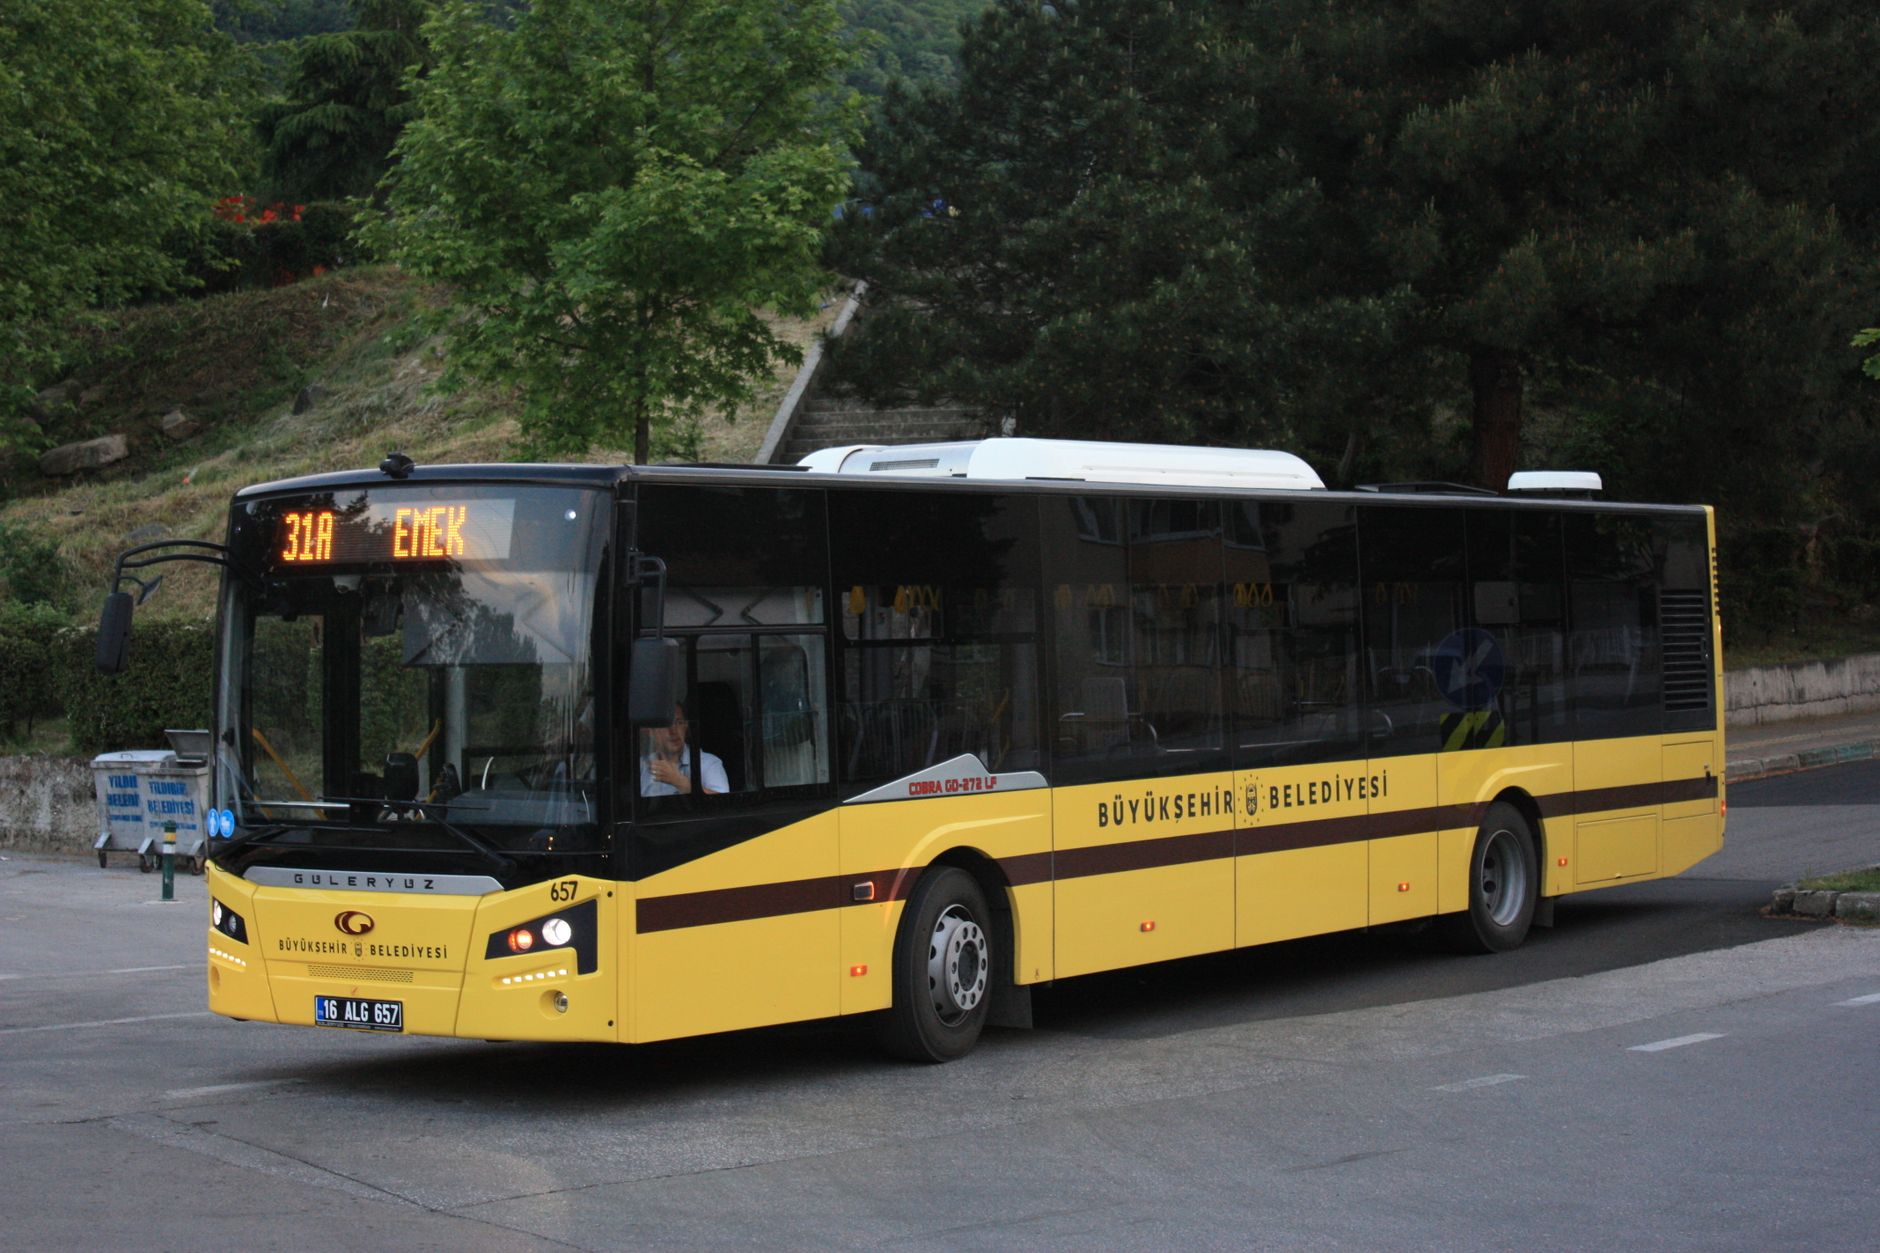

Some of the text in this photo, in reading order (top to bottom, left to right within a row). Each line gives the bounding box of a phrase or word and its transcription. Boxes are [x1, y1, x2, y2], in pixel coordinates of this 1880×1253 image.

[283, 506, 465, 561] 31A EMEK
[909, 781, 942, 795] COBRA
[985, 776, 997, 789] LF
[1099, 770, 1387, 828] BÜYÜKŞEHİR BELEDİYESİ
[551, 881, 578, 902] 657
[370, 943, 447, 959] BELEDİYESİ
[324, 1000, 399, 1024] 16 ALG 657
